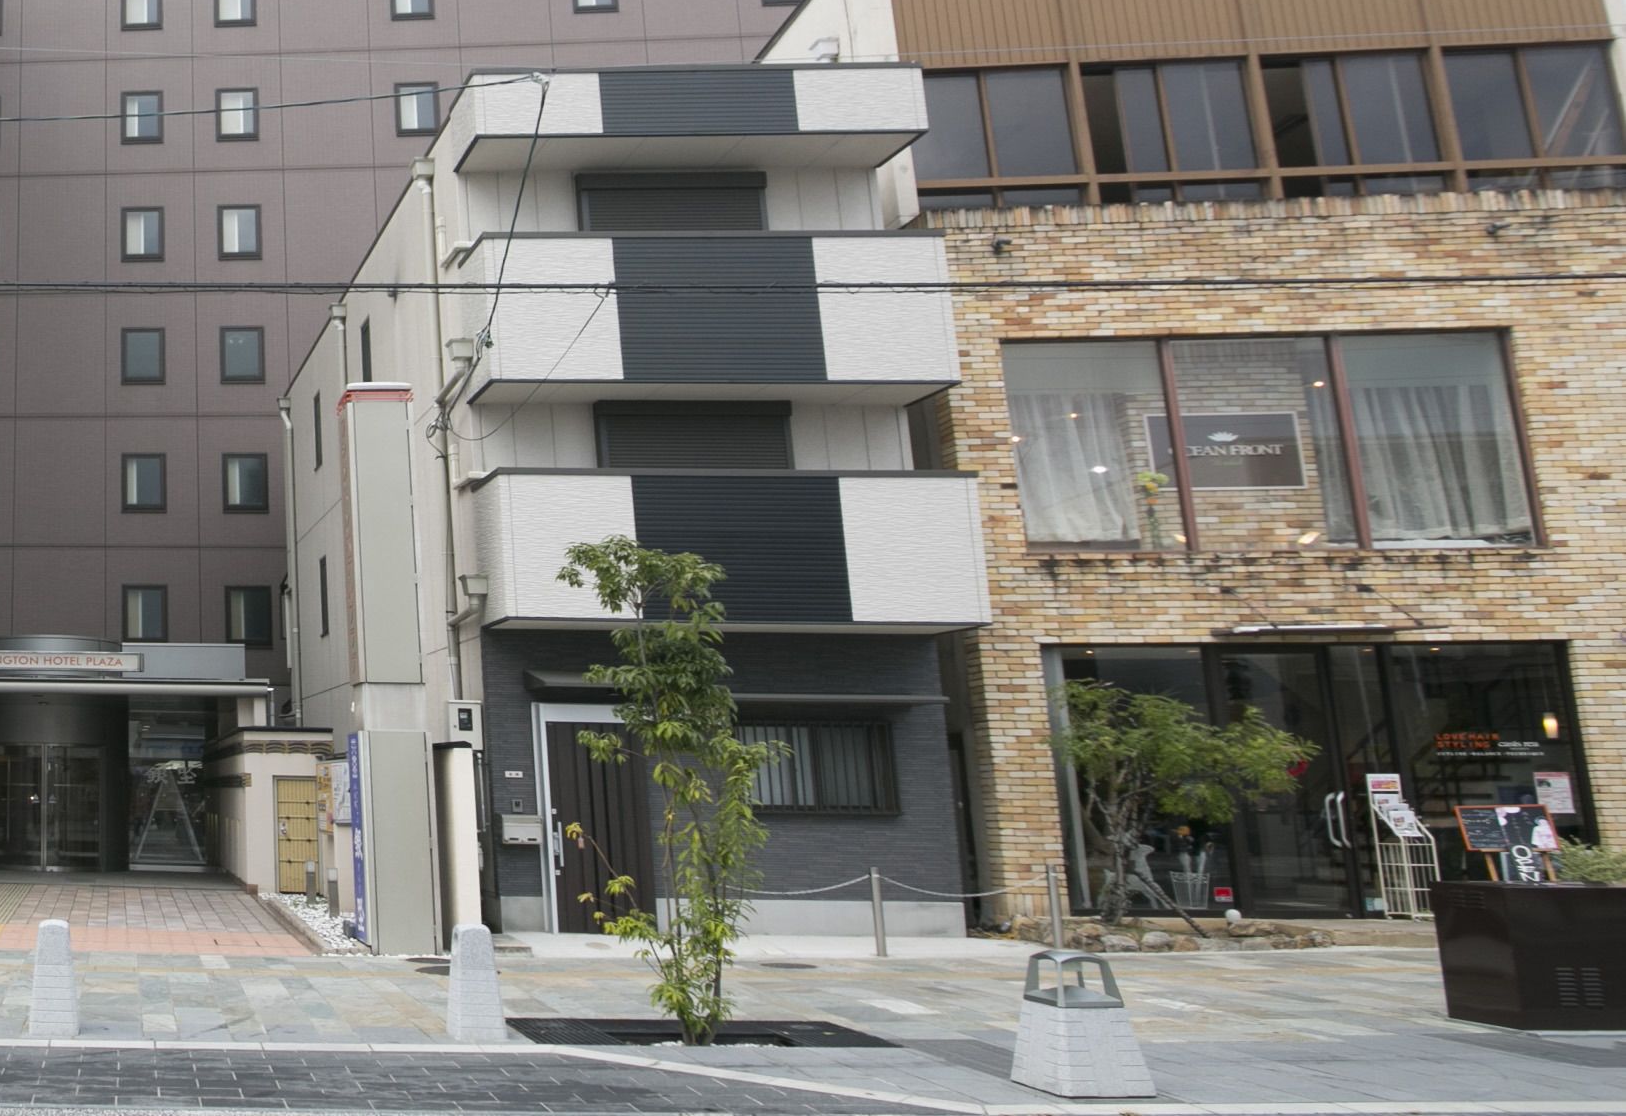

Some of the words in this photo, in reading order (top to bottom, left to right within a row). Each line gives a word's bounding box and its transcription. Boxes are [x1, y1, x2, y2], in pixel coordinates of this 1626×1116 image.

[1230, 443, 1283, 456] FRONT
[43, 657, 82, 666] HOTEL
[86, 658, 123, 667] PLAZA
